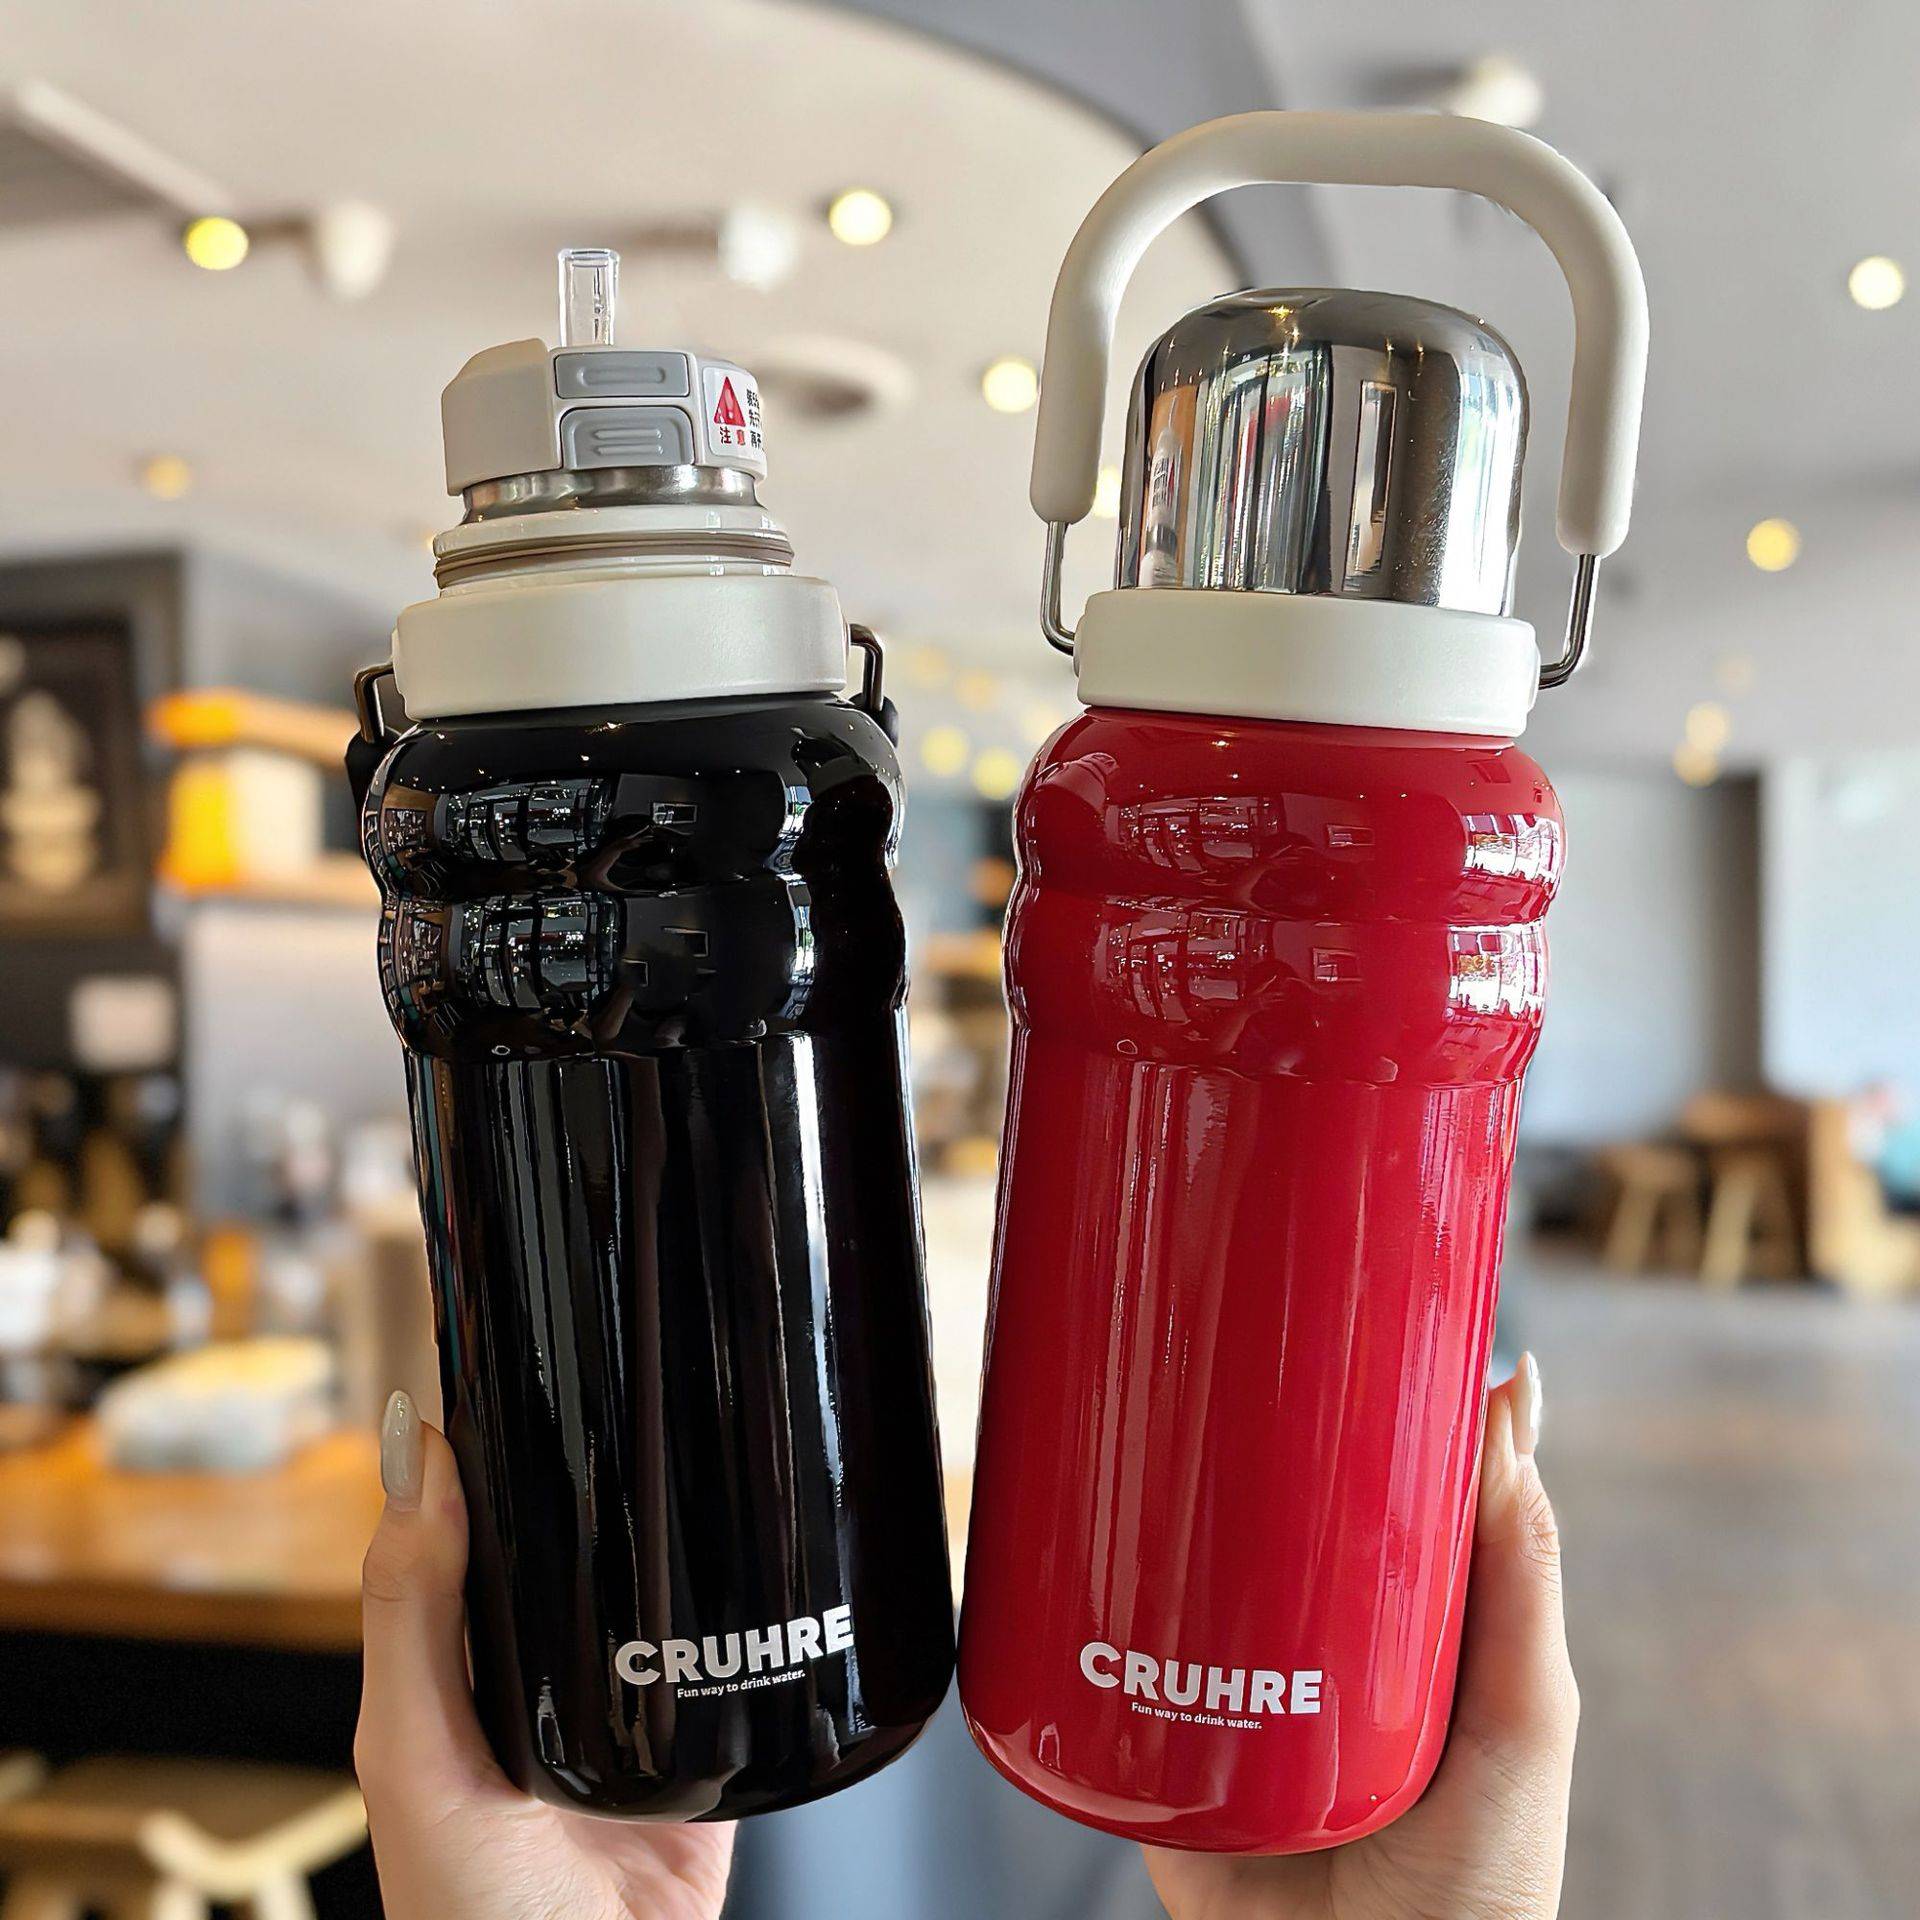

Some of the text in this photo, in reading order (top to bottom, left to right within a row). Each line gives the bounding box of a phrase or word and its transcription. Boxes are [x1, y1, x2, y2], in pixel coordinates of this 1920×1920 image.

[615, 1604, 854, 1686] CRUHRE
[677, 1669, 806, 1699] Fun way to drink water.
[1080, 1642, 1323, 1714] CRUHRE
[1131, 1702, 1263, 1730] Fun way to drink water.
